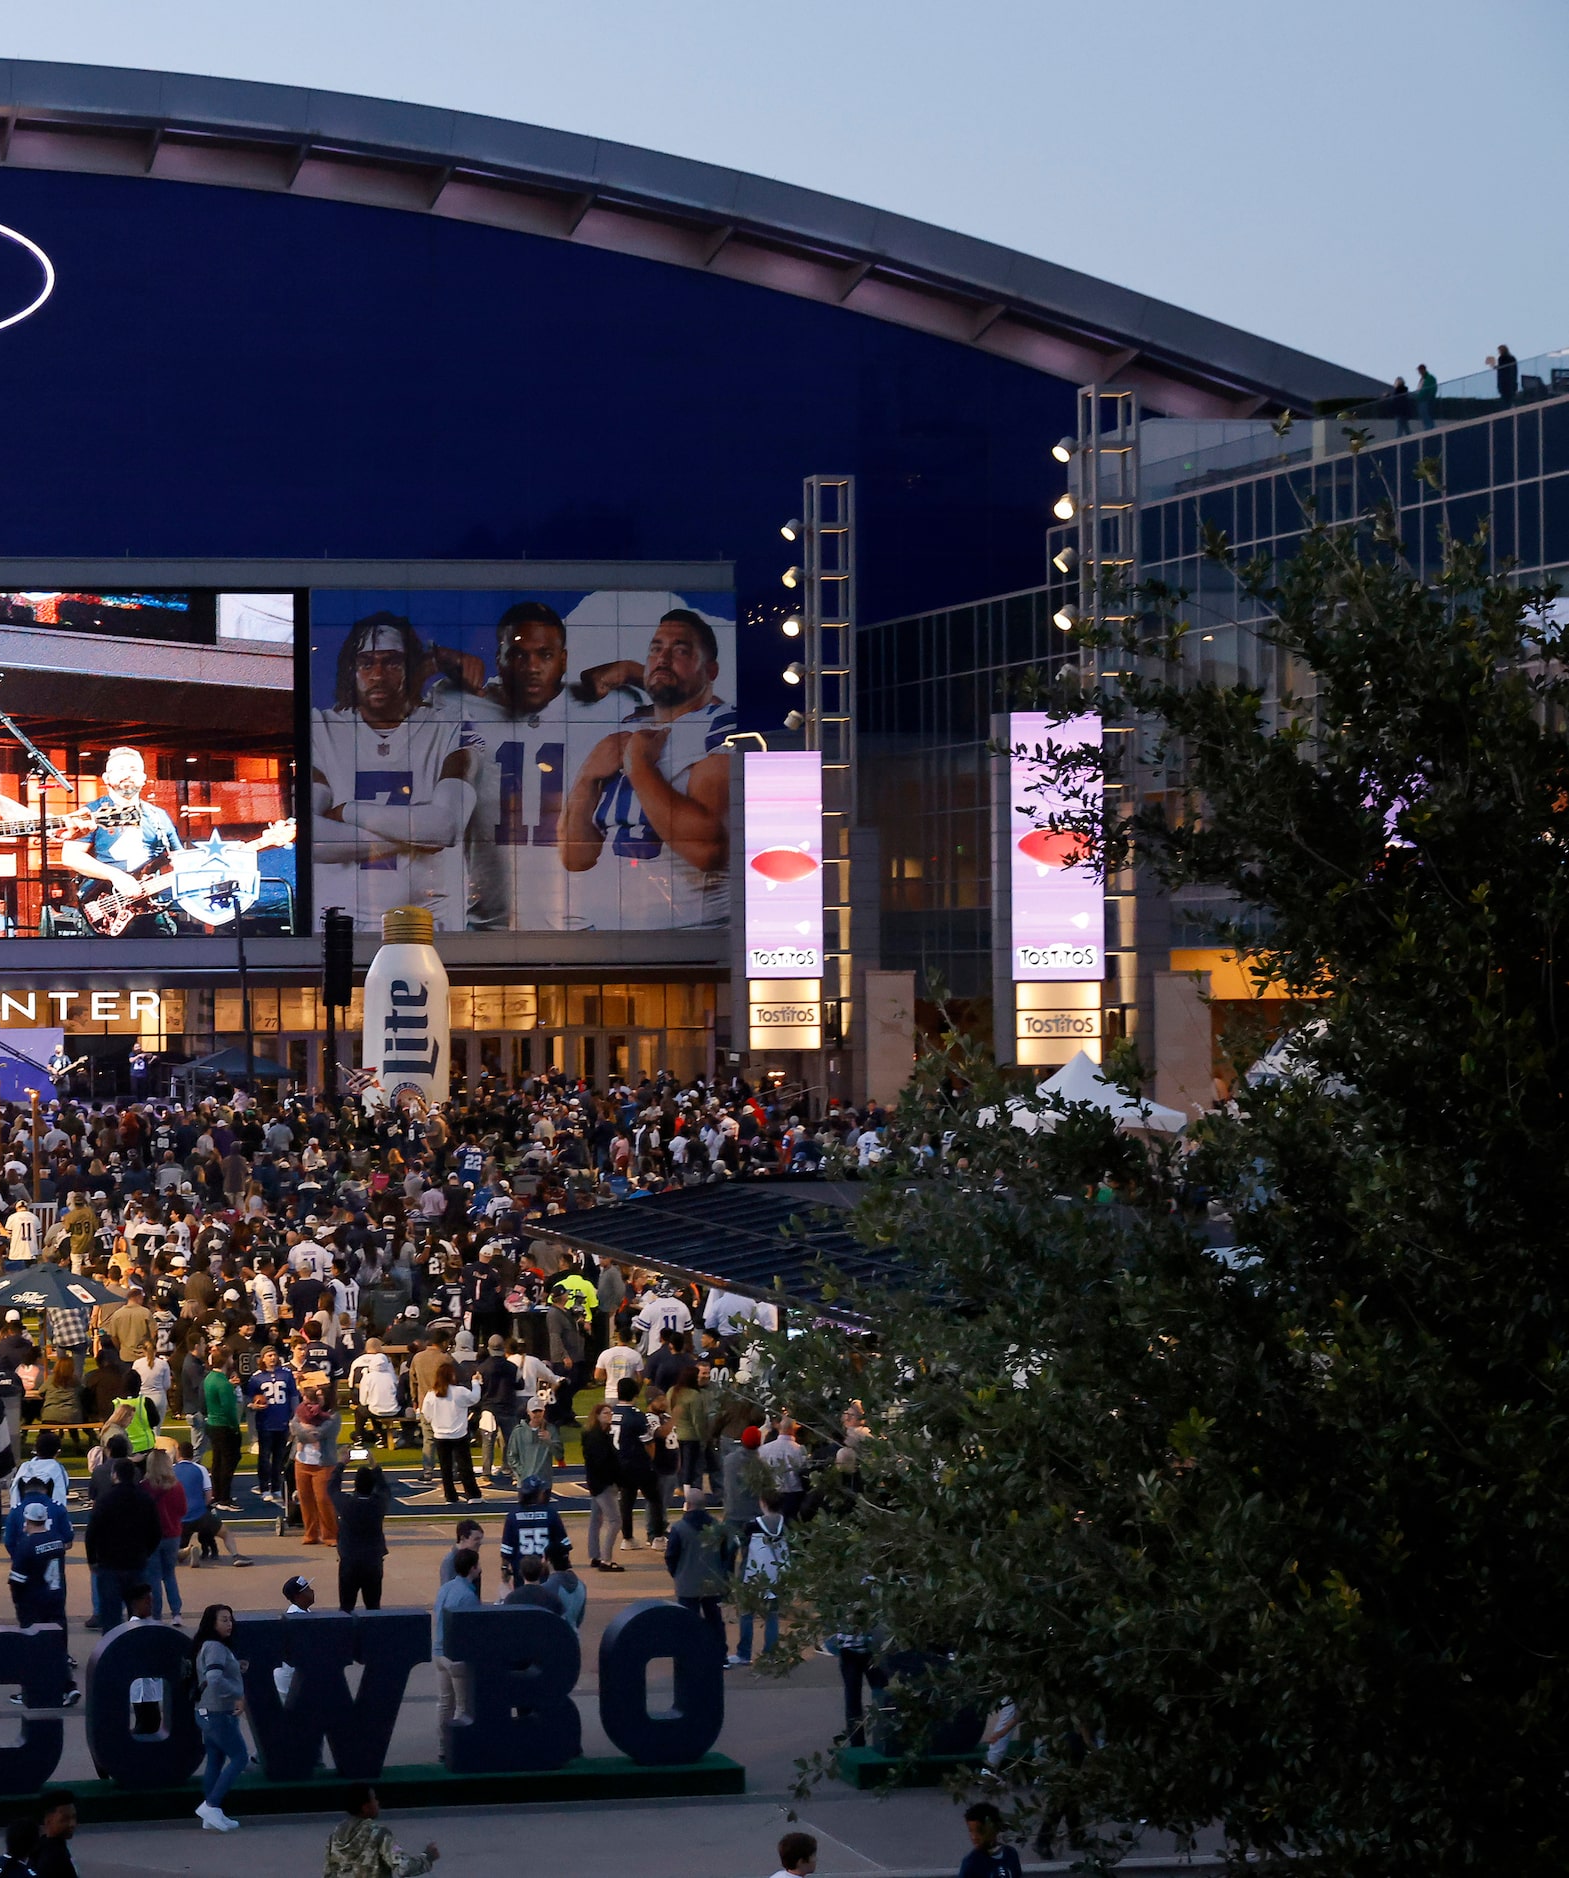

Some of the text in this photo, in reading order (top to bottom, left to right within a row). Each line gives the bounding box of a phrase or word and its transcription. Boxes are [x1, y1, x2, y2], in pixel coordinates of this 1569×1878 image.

[495, 742, 565, 846] 11
[756, 1006, 815, 1024] TOSTITOS
[1025, 1013, 1094, 1033] TOSTITOS
[383, 980, 439, 1082] Lite
[464, 1154, 483, 1171] 22
[20, 1222, 32, 1241] 11
[345, 1290, 356, 1311] 11
[448, 1294, 461, 1318] 4
[259, 1380, 287, 1405] 26
[518, 1527, 550, 1555] 55
[43, 1557, 61, 1591] 4
